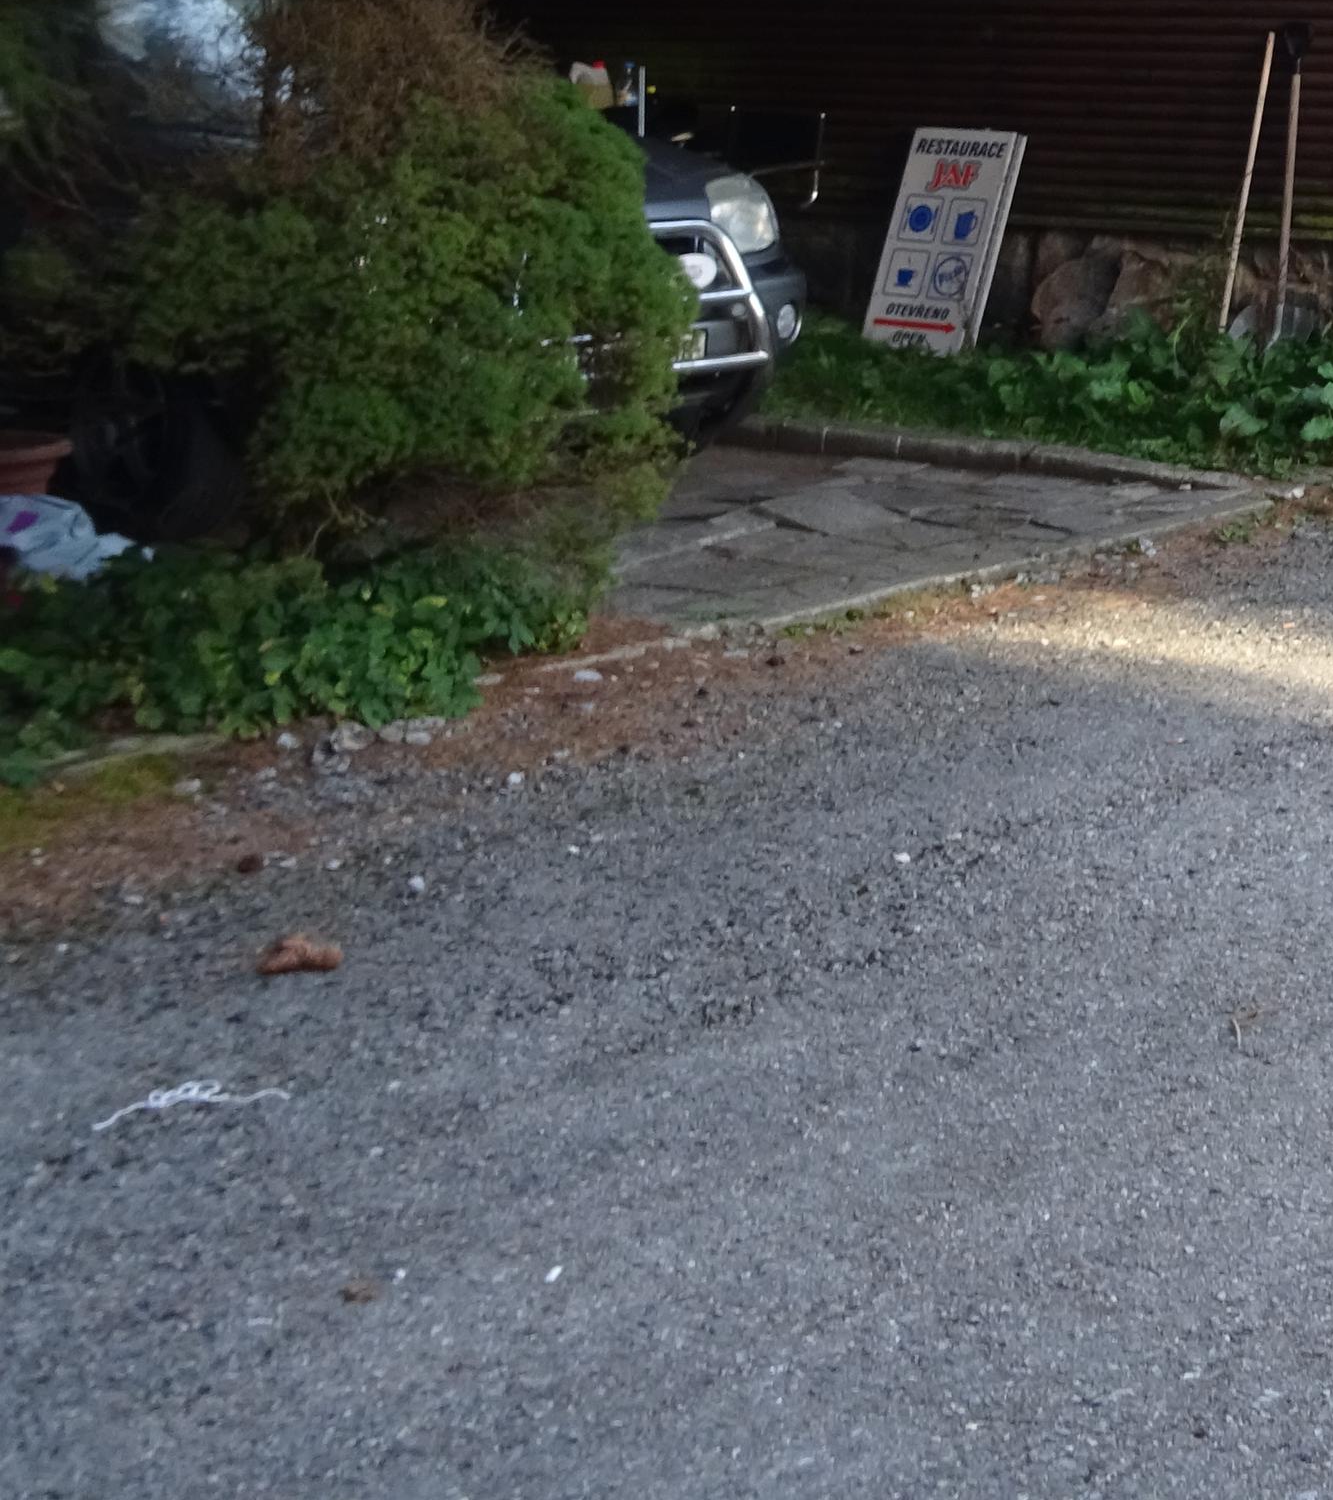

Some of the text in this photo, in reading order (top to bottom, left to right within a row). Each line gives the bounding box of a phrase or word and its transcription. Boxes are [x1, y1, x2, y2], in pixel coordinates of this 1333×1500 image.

[916, 138, 1008, 158] RESTAURACE
[925, 158, 982, 193] JAF
[885, 302, 951, 321] OTEVŘENO
